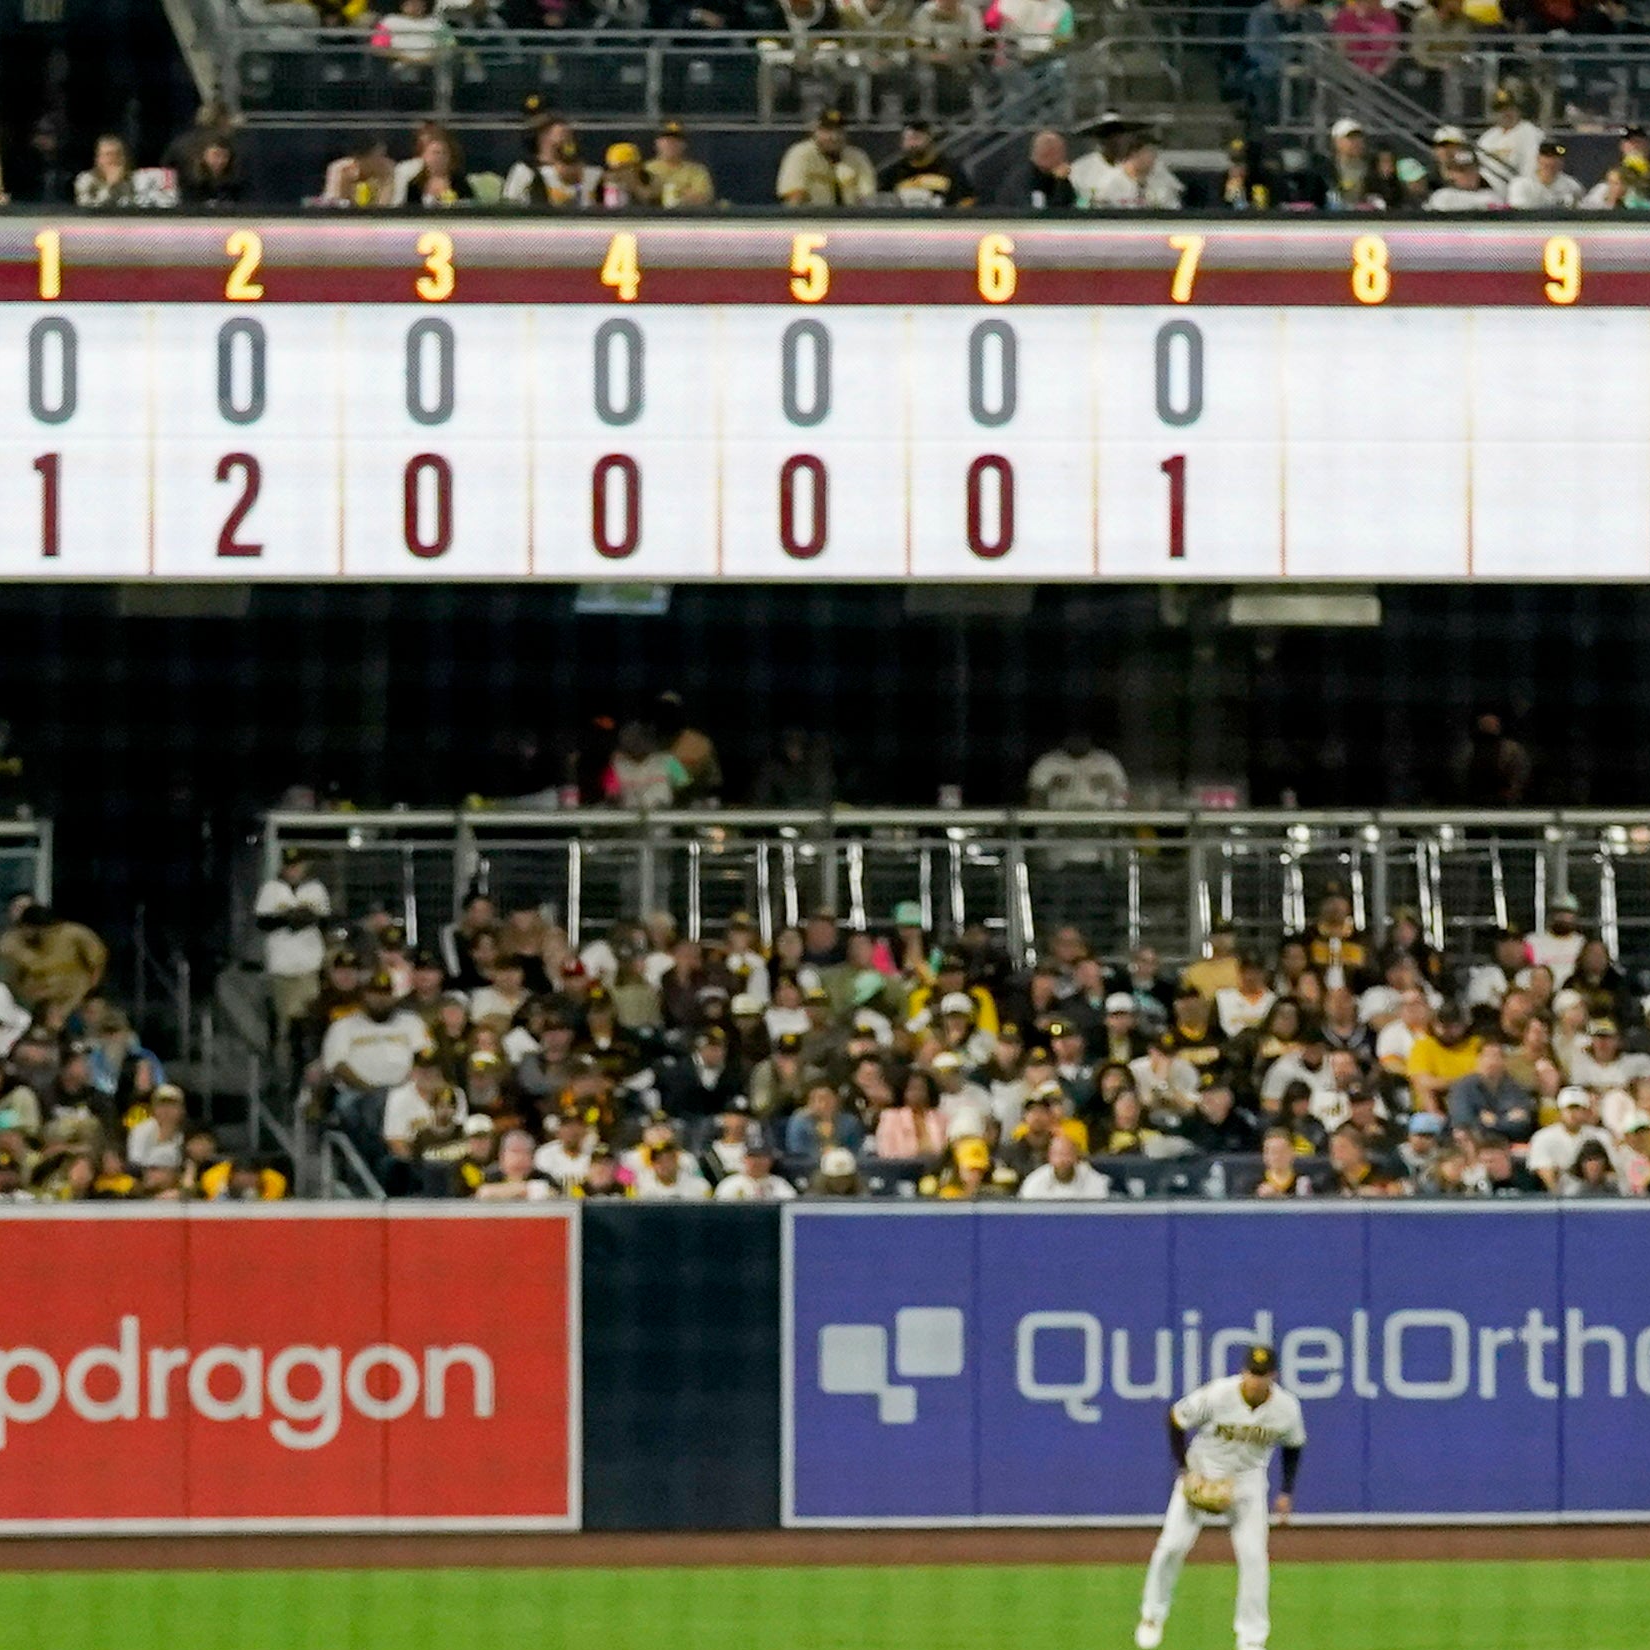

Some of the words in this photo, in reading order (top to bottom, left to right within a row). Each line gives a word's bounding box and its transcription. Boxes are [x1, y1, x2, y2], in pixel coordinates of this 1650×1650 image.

[34, 229, 62, 299] 1
[225, 230, 264, 300] 2
[416, 231, 456, 301] 3
[600, 233, 640, 301] 4
[790, 232, 829, 303] 5
[977, 234, 1015, 303] 6
[1169, 235, 1205, 303] 7
[1352, 236, 1389, 304] 8
[1543, 237, 1581, 304] 9
[27, 317, 78, 425] 0
[217, 317, 266, 426] 0
[405, 317, 455, 426] 0
[594, 318, 644, 426] 0
[781, 318, 832, 427] 0
[968, 319, 1017, 427] 0
[1155, 319, 1203, 427] 0
[33, 452, 61, 557] 1
[215, 452, 263, 557] 2
[403, 453, 453, 559] 0
[592, 453, 642, 559] 0
[780, 453, 827, 559] 0
[966, 453, 1014, 559] 0
[1160, 454, 1186, 558] 1
